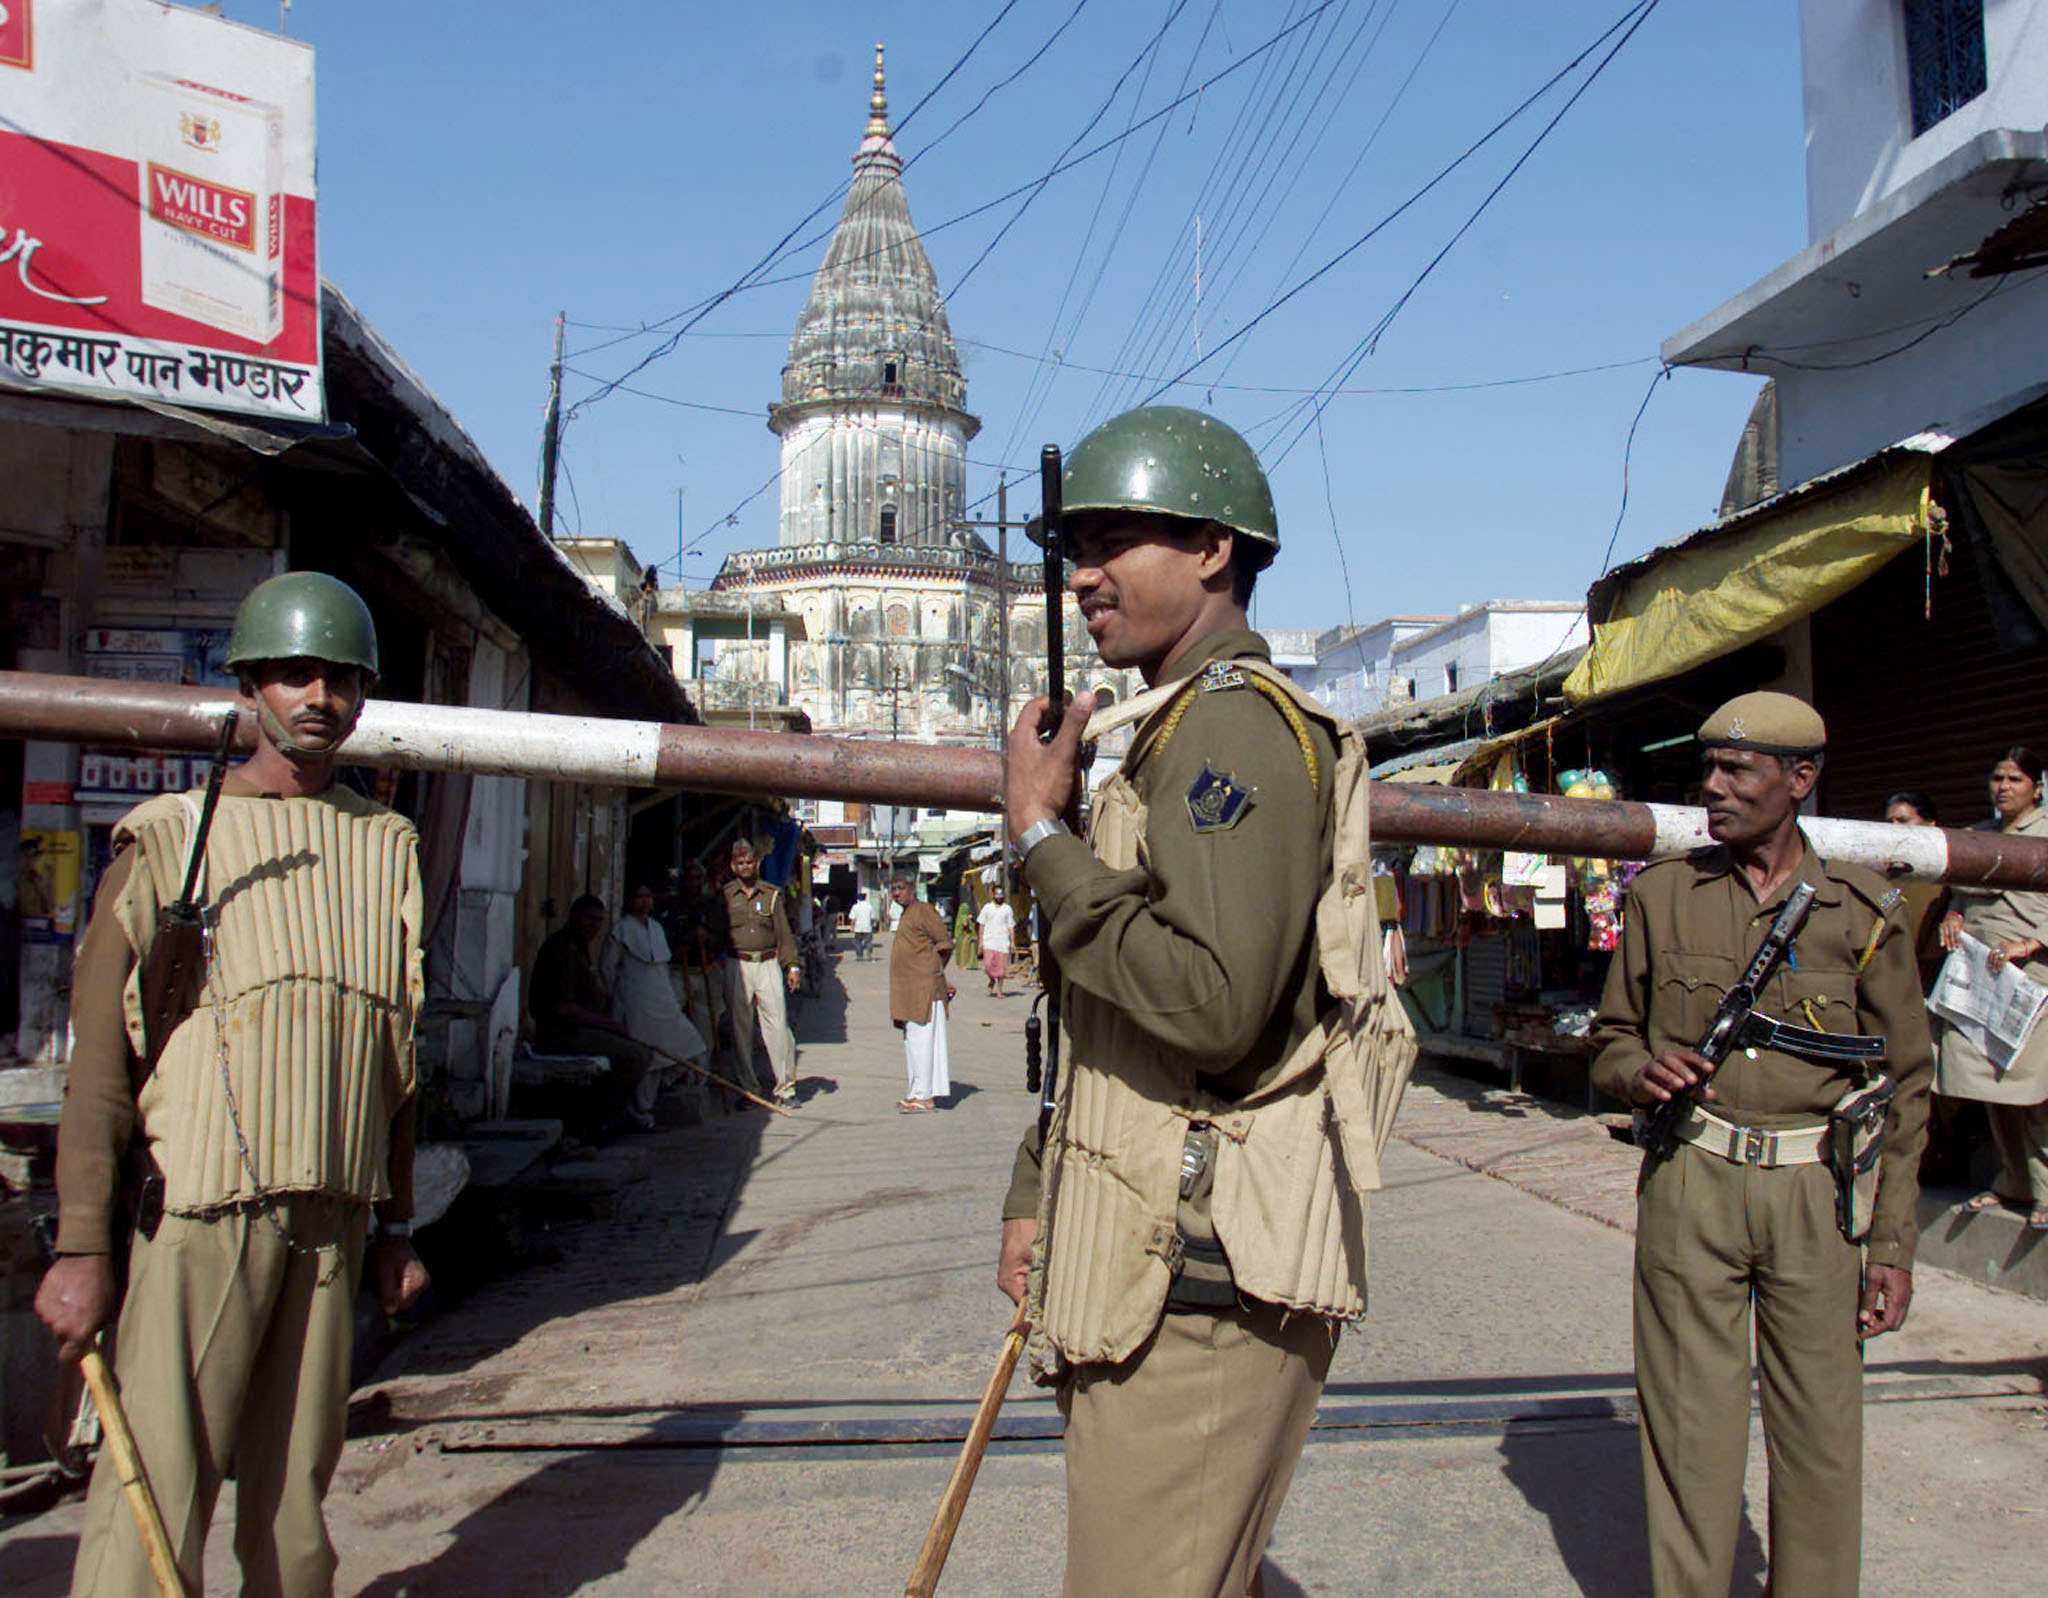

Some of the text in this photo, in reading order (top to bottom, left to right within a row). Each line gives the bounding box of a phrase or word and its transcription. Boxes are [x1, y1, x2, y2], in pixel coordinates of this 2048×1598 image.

[155, 172, 247, 227] WILLS
[164, 208, 238, 241] NAVY CUT
[126, 351, 184, 391] पान
[188, 349, 310, 411] भण्डार
